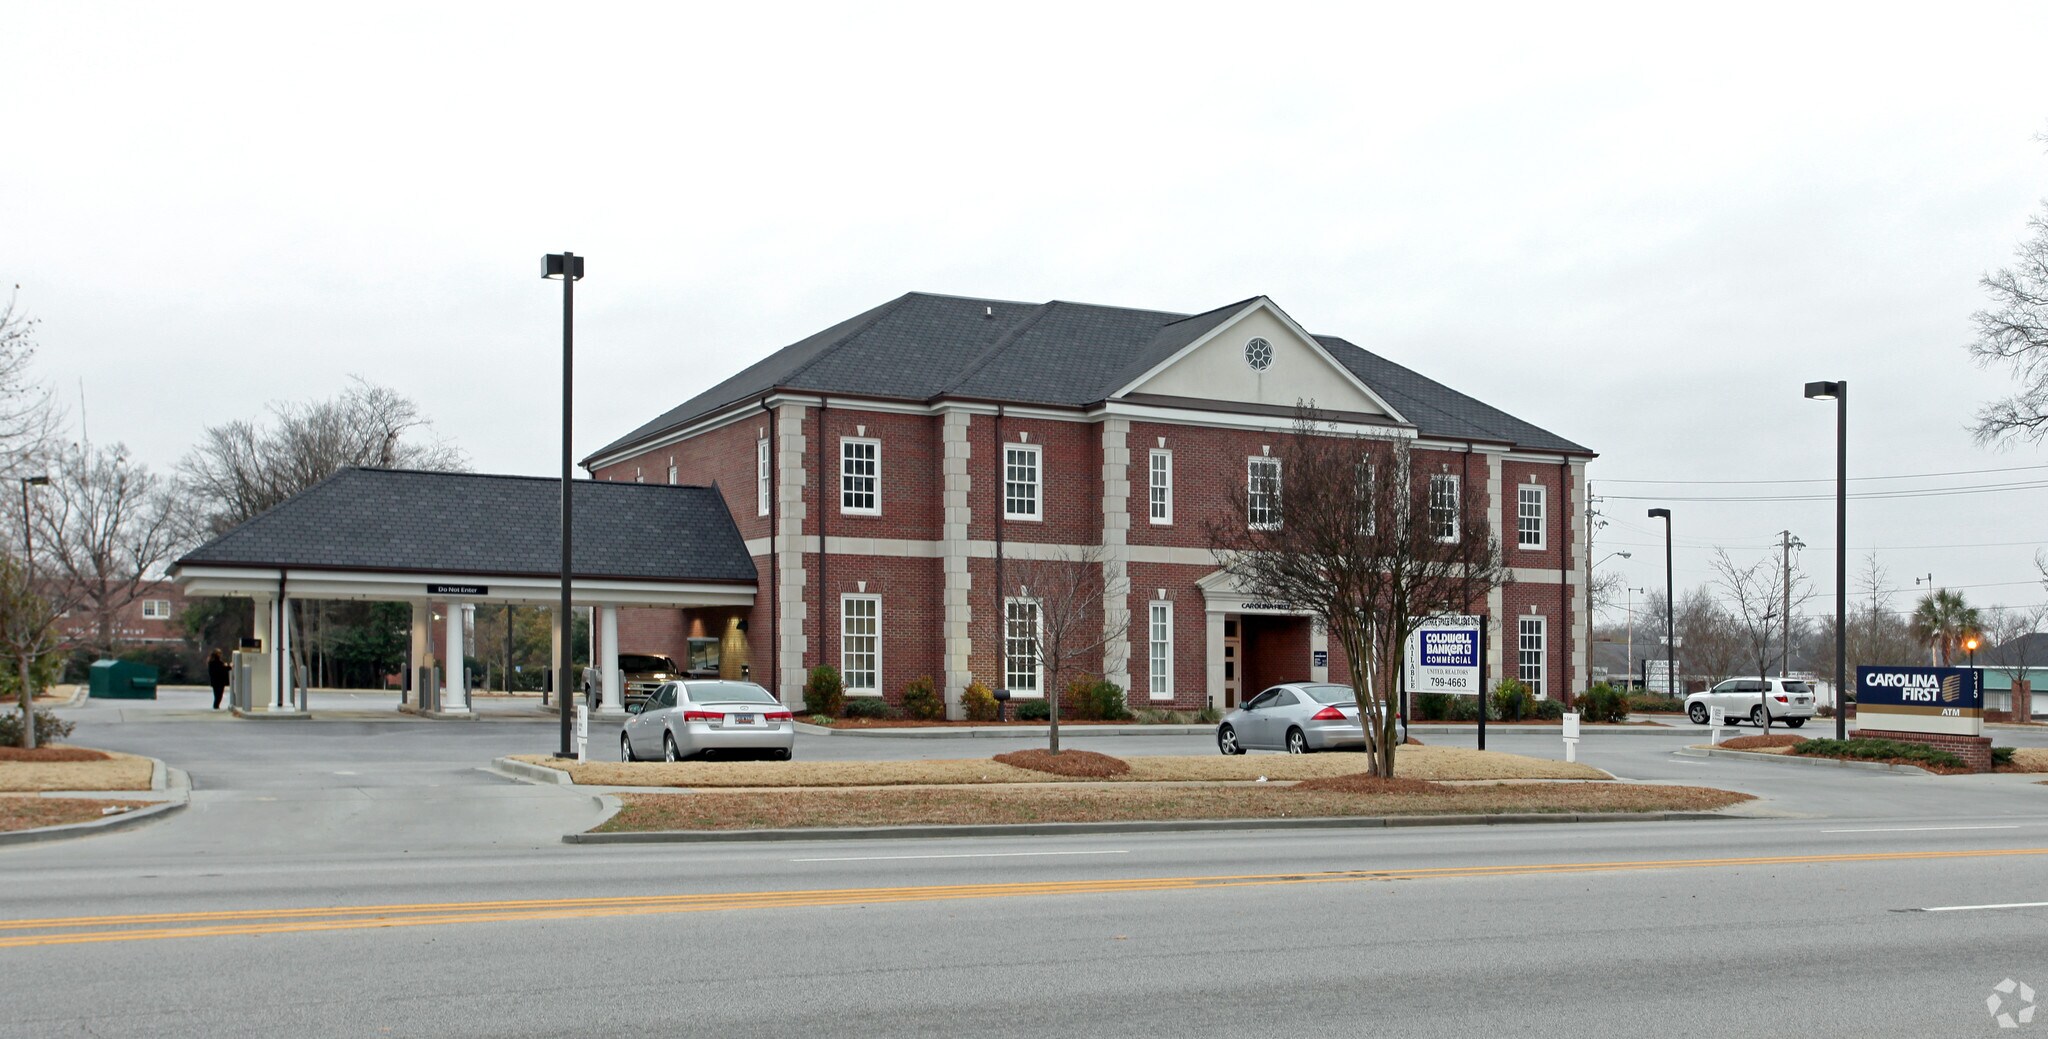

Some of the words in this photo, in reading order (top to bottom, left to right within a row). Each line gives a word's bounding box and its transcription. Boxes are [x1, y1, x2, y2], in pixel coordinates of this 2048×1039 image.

[1241, 602, 1274, 610] CAROLINA
[1425, 633, 1472, 644] COLDWELL
[1426, 644, 1464, 656] BANKER
[1426, 656, 1472, 664] COMMERCIAL
[1430, 677, 1467, 688] 799-4663
[1865, 672, 1939, 688] CAROLINA
[1902, 688, 1940, 702] FIRST
[1941, 708, 1960, 716] ATM
